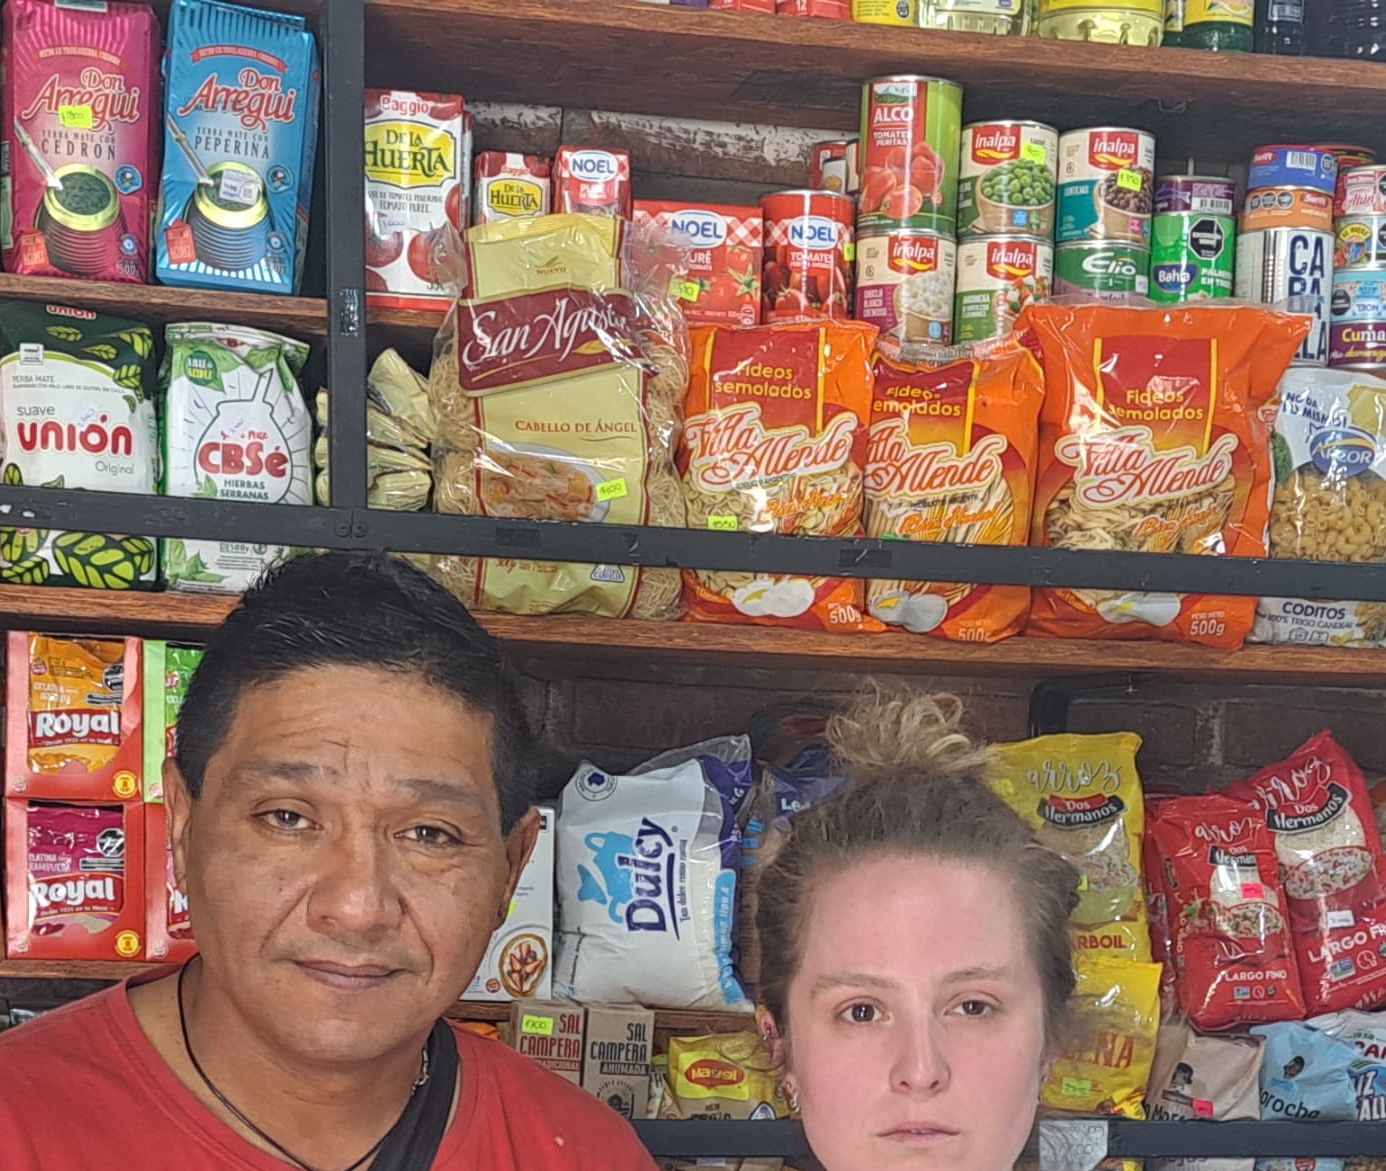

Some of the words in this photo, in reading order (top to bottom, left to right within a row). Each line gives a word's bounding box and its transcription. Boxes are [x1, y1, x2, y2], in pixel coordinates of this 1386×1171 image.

[79, 67, 126, 94] Don
[237, 67, 283, 94] Don
[177, 77, 298, 132] Arregui
[873, 106, 914, 124] ALCO
[40, 138, 117, 161] CEDRON
[194, 134, 272, 161] PEPERINA
[974, 131, 1017, 154] inalpa
[1092, 138, 1136, 161] inalpa
[571, 156, 616, 174] NOEL
[490, 190, 539, 211] HUERTA
[670, 219, 723, 240] NOEL
[790, 223, 838, 242] NOEL
[891, 243, 935, 264] inalpa
[991, 249, 1034, 268] inalpa
[714, 379, 813, 401] semolados
[1126, 388, 1186, 404] Fideos
[16, 403, 56, 418] suave
[514, 420, 572, 435] CABELLO
[574, 421, 592, 434] DE
[594, 417, 638, 435] ÁNGEL
[94, 460, 135, 476] Original
[197, 442, 289, 480] CBSé
[873, 438, 996, 492] Allende
[1098, 445, 1227, 498] Allende
[219, 488, 271, 501] SERRANAS
[223, 478, 267, 491] HIERBAS
[1281, 601, 1347, 621] CODITOS
[34, 712, 121, 746] Royal
[1043, 803, 1119, 821] Hermanos
[1065, 799, 1091, 812] Dos
[1273, 794, 1345, 832] Hermanos
[1292, 802, 1317, 816] Dos
[26, 876, 116, 906] Royal
[1307, 931, 1367, 964] LARGO
[1224, 970, 1264, 982] LARGO
[1265, 968, 1288, 981] FINO
[557, 1012, 581, 1033] SAL
[626, 1021, 648, 1042] SAL
[519, 1035, 581, 1058] CAMPERA
[590, 1041, 647, 1063] CAMPERA
[600, 1063, 649, 1075] AHUMADA
[690, 1065, 739, 1084] Maggi
